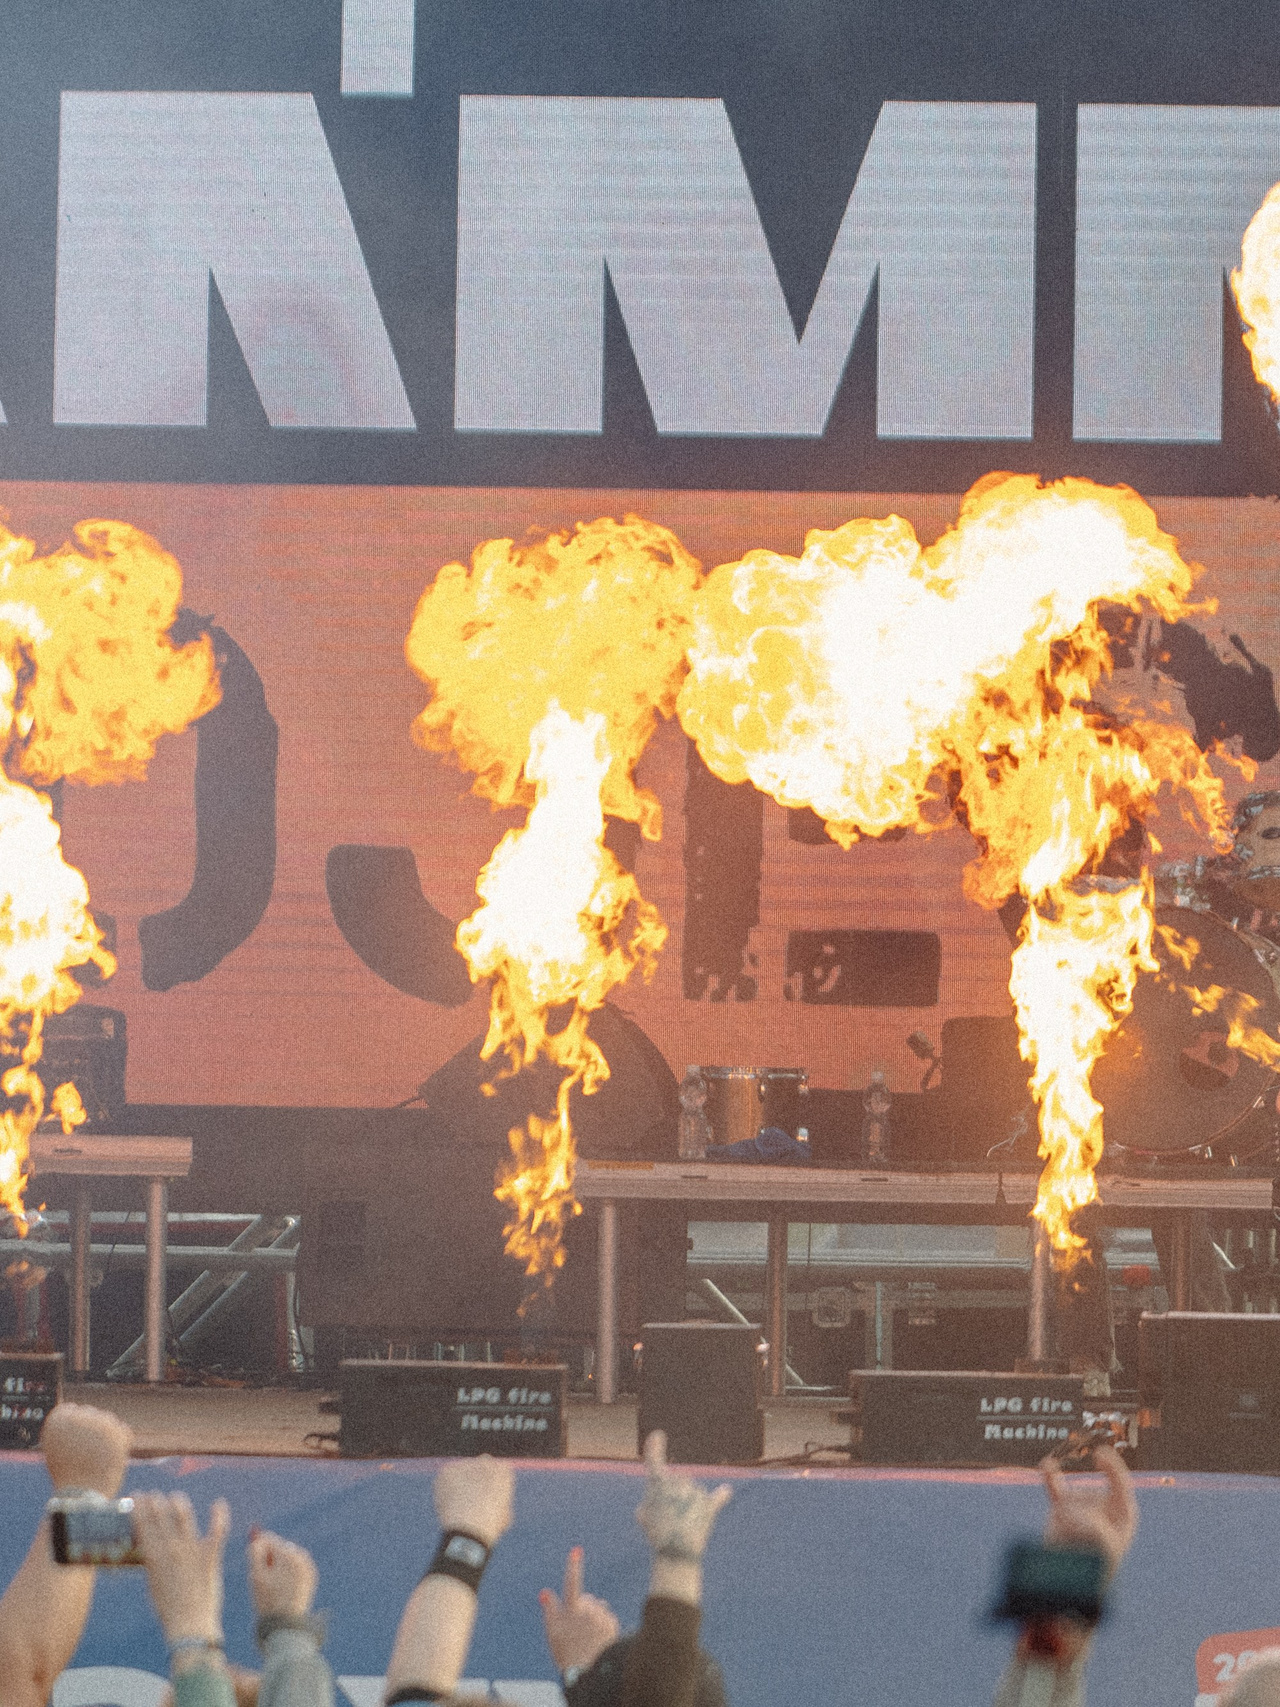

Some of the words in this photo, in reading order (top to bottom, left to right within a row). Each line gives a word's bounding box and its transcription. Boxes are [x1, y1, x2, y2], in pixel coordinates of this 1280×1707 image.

[457, 1386, 501, 1404] LPG
[508, 1386, 552, 1404] fire
[980, 1396, 1023, 1413] LPG
[1029, 1396, 1073, 1413] fire
[460, 1413, 549, 1431] Machine
[984, 1424, 1069, 1440] Machine
